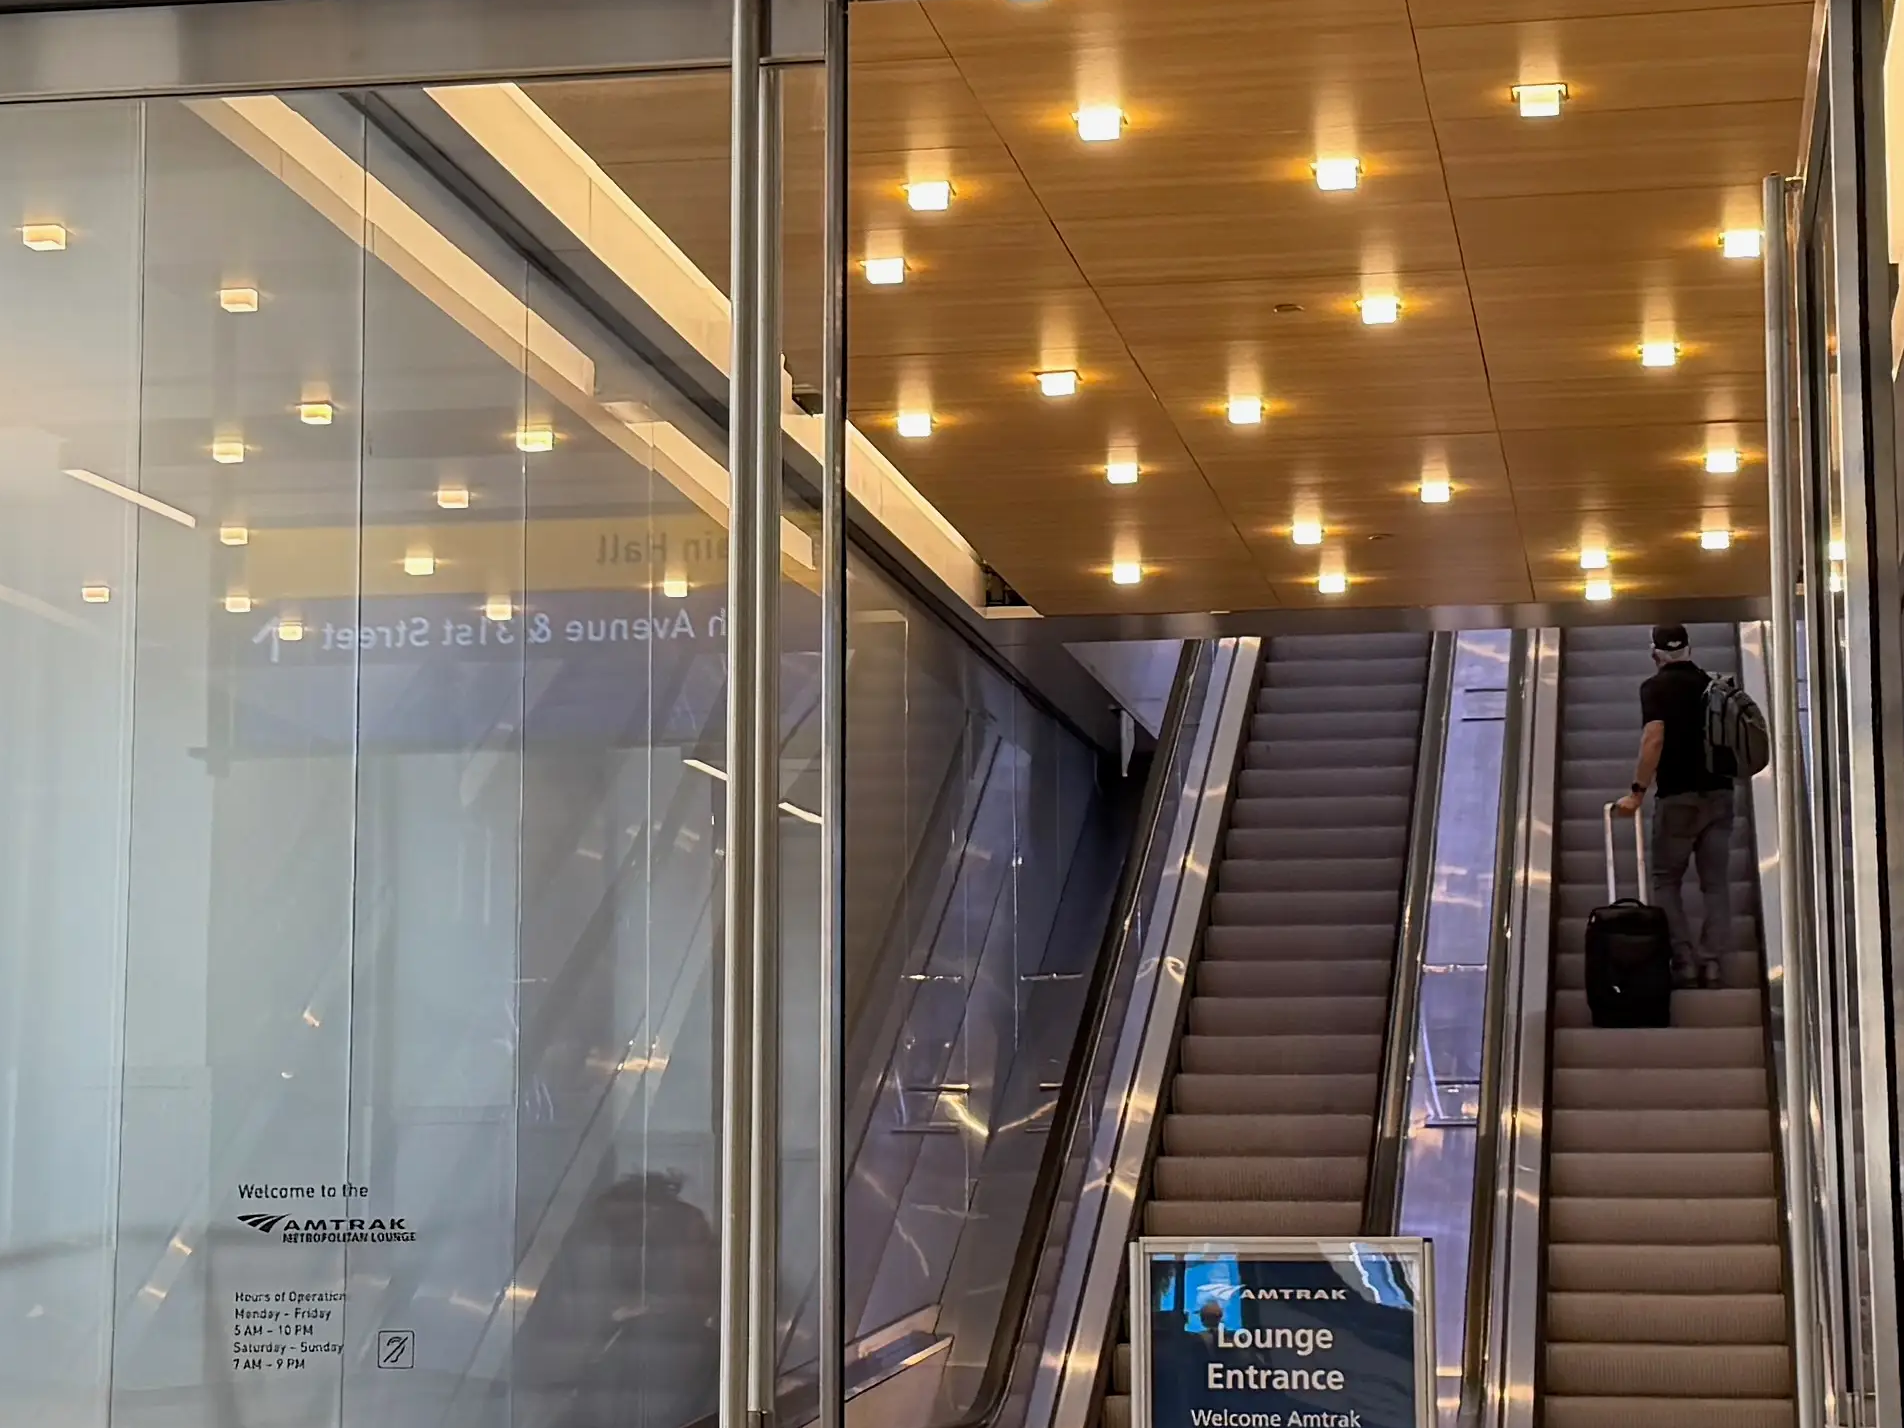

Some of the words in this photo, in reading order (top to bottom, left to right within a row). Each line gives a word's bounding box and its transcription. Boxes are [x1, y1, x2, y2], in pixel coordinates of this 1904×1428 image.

[238, 1184, 315, 1199] Welcome
[321, 1184, 336, 1198] to
[342, 1184, 369, 1198] the
[283, 1218, 406, 1231] AMTRAK
[282, 1232, 369, 1244] METROPOLITAN
[371, 1231, 416, 1243] LOUNGE
[235, 1292, 271, 1302] Hours
[274, 1292, 285, 1302] of
[289, 1291, 346, 1304] Operation
[1240, 1288, 1347, 1300] AMTRAK
[235, 1308, 280, 1322] Monday
[294, 1307, 332, 1322] Friday
[234, 1324, 241, 1336] 5
[244, 1325, 263, 1336] AM
[279, 1324, 291, 1336] 10
[295, 1324, 313, 1336] PM
[1218, 1322, 1334, 1356] Lounge
[233, 1341, 287, 1355] Saturday
[300, 1341, 345, 1355] Sunday
[233, 1358, 240, 1370] 7
[243, 1358, 262, 1370] AM
[276, 1358, 283, 1369] 9
[287, 1358, 305, 1370] PM
[1207, 1363, 1345, 1391] Entrance
[1190, 1409, 1281, 1427] Welcome
[1287, 1409, 1362, 1428] Amtrak
